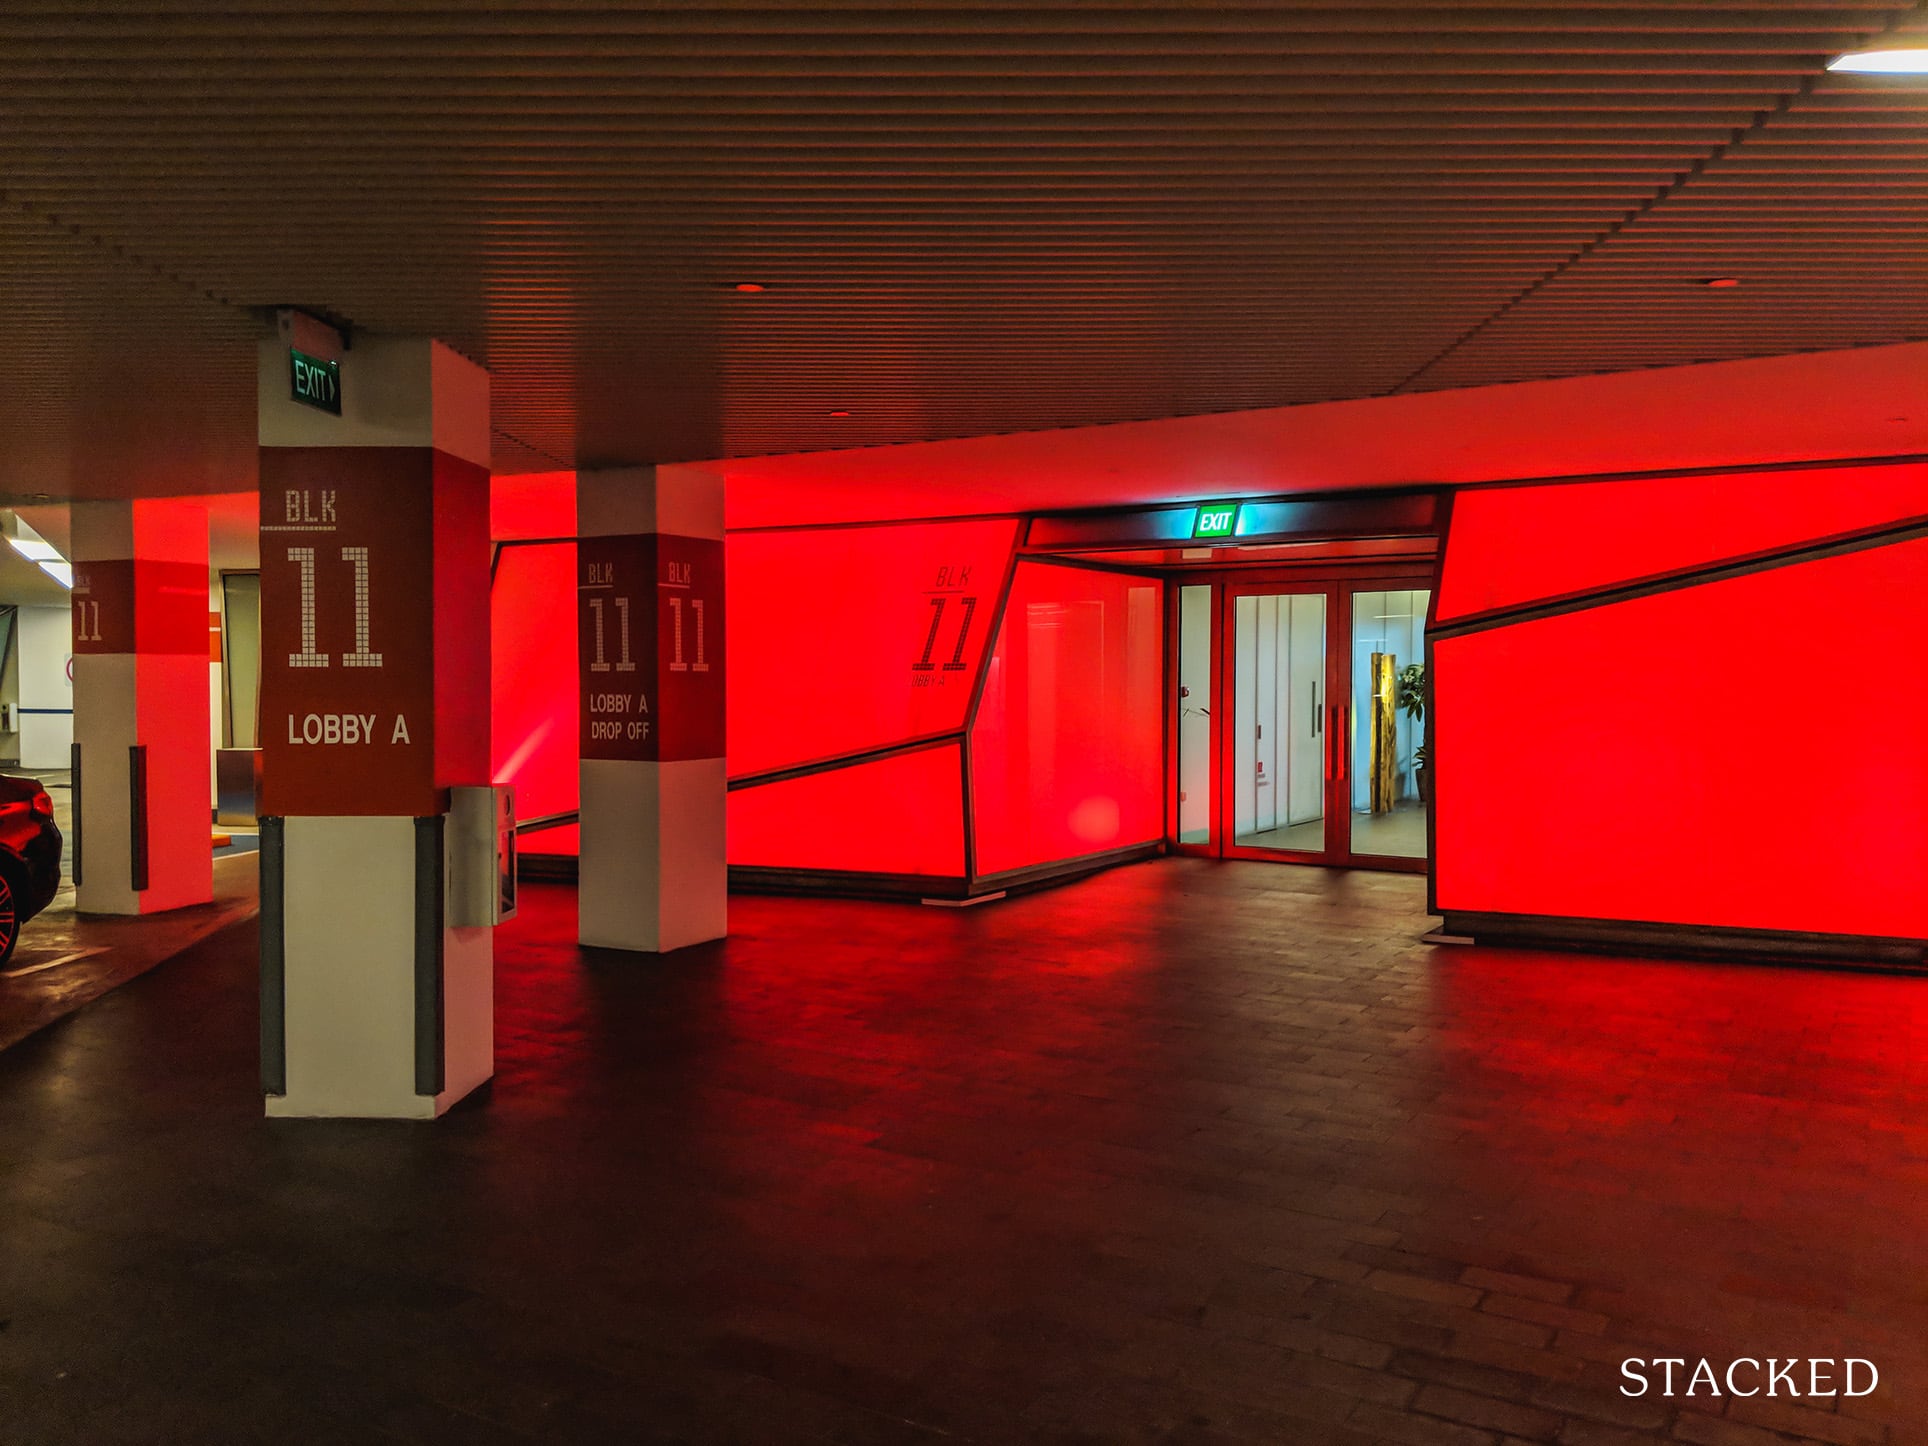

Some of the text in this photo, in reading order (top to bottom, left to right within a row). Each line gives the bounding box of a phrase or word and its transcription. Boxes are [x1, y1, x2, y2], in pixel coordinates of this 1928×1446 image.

[295, 359, 327, 401] EXIT
[286, 490, 337, 522] BLK
[1200, 511, 1233, 532] EXIT
[588, 563, 613, 584] BLK
[669, 562, 690, 583] BLK
[936, 566, 971, 587] BLK
[78, 601, 102, 640] 11
[288, 547, 383, 667] 11
[590, 598, 635, 672] 11
[670, 598, 709, 672] 11
[912, 597, 977, 671] 11
[910, 674, 936, 687] OBBY
[590, 694, 648, 713] LOBBY A
[288, 714, 411, 744] LOBBY A
[591, 722, 649, 740] DROP OFF
